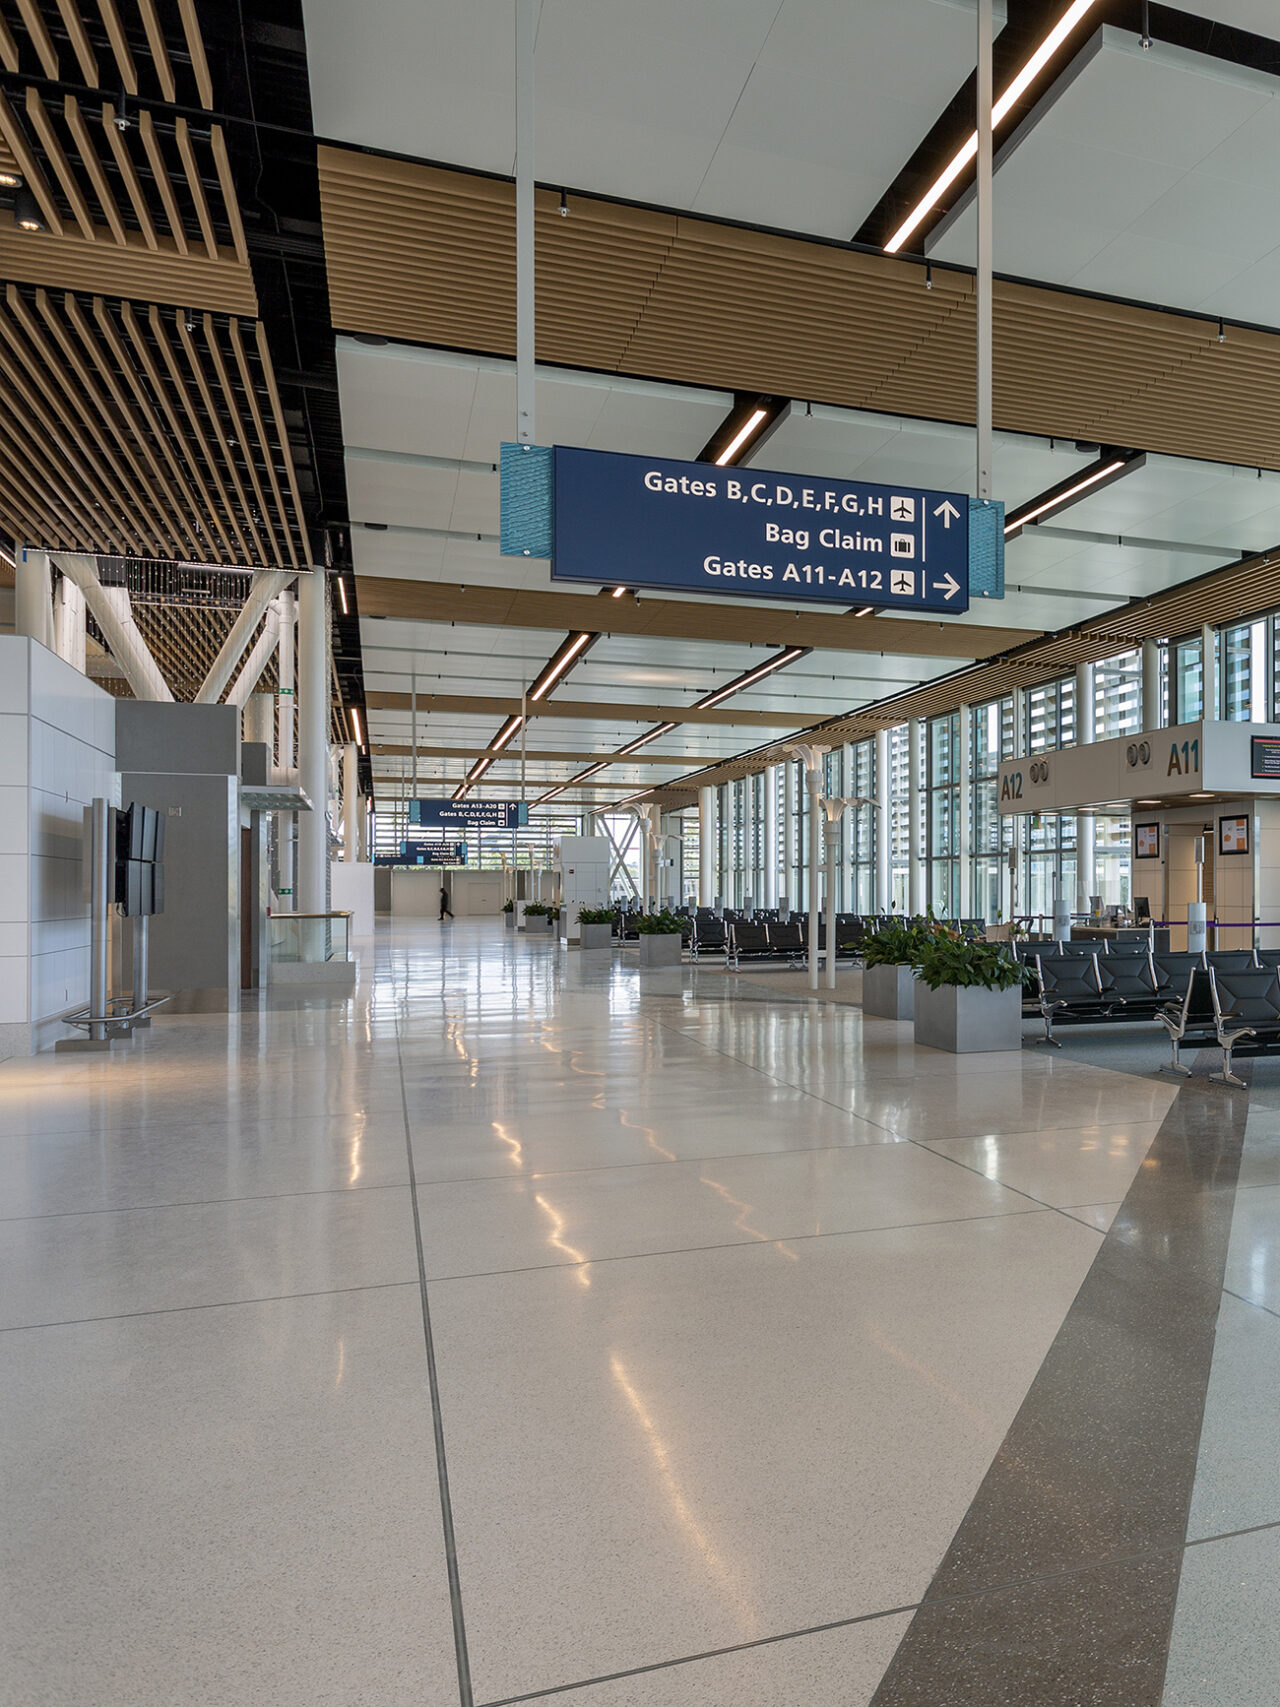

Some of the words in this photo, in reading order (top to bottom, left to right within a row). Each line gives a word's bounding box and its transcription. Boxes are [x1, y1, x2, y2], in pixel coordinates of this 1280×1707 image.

[643, 470, 717, 498] Gates
[726, 480, 884, 516] B,C,D,E,F,G,H
[765, 523, 810, 550] Bag
[819, 528, 884, 553] Claim
[703, 555, 774, 580] Gates
[782, 563, 884, 590] A11-A12
[1167, 739, 1199, 777] A11
[1001, 772, 1023, 801] A12
